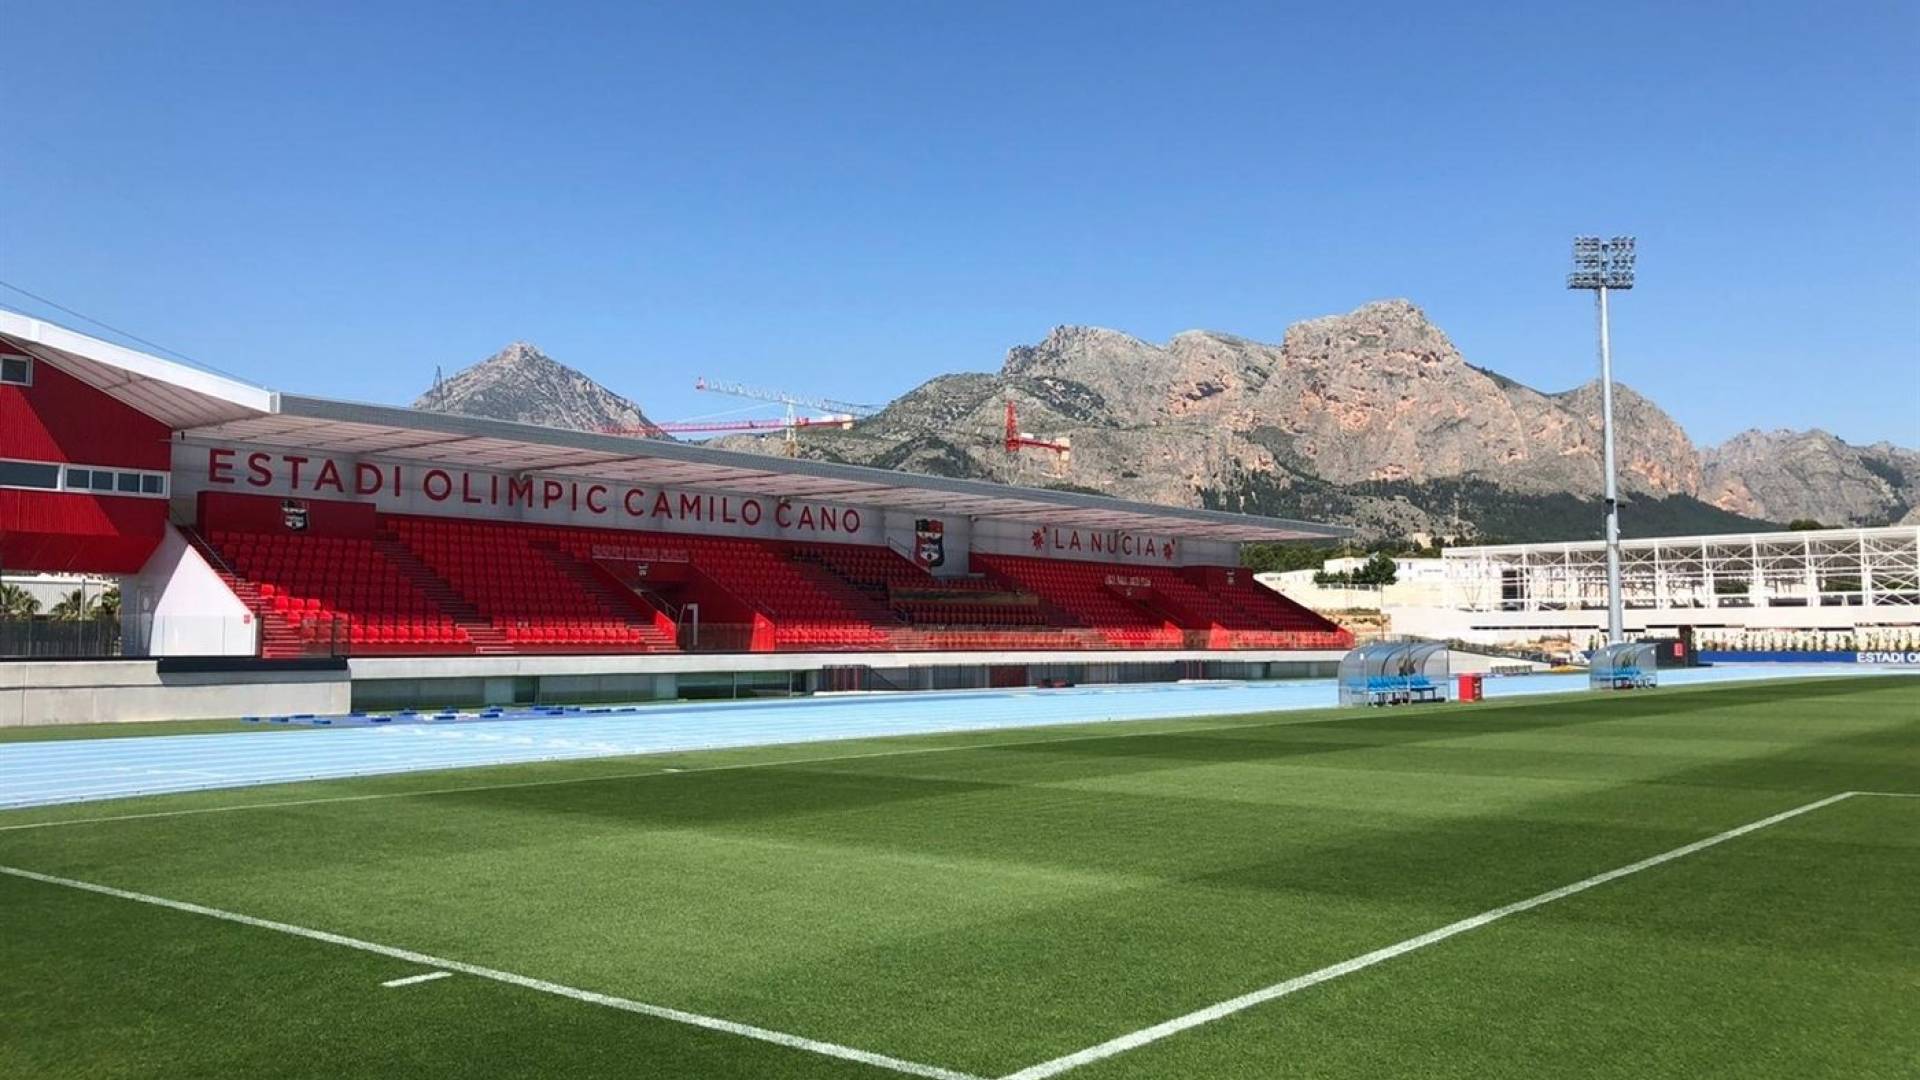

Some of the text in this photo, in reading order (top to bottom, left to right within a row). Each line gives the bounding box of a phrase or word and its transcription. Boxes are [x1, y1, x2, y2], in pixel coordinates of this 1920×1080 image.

[208, 447, 861, 534] ESTADI OLIMPIC CAMILO CANO
[1054, 528, 1082, 551] LA
[1856, 652, 1905, 663] ESTADI
